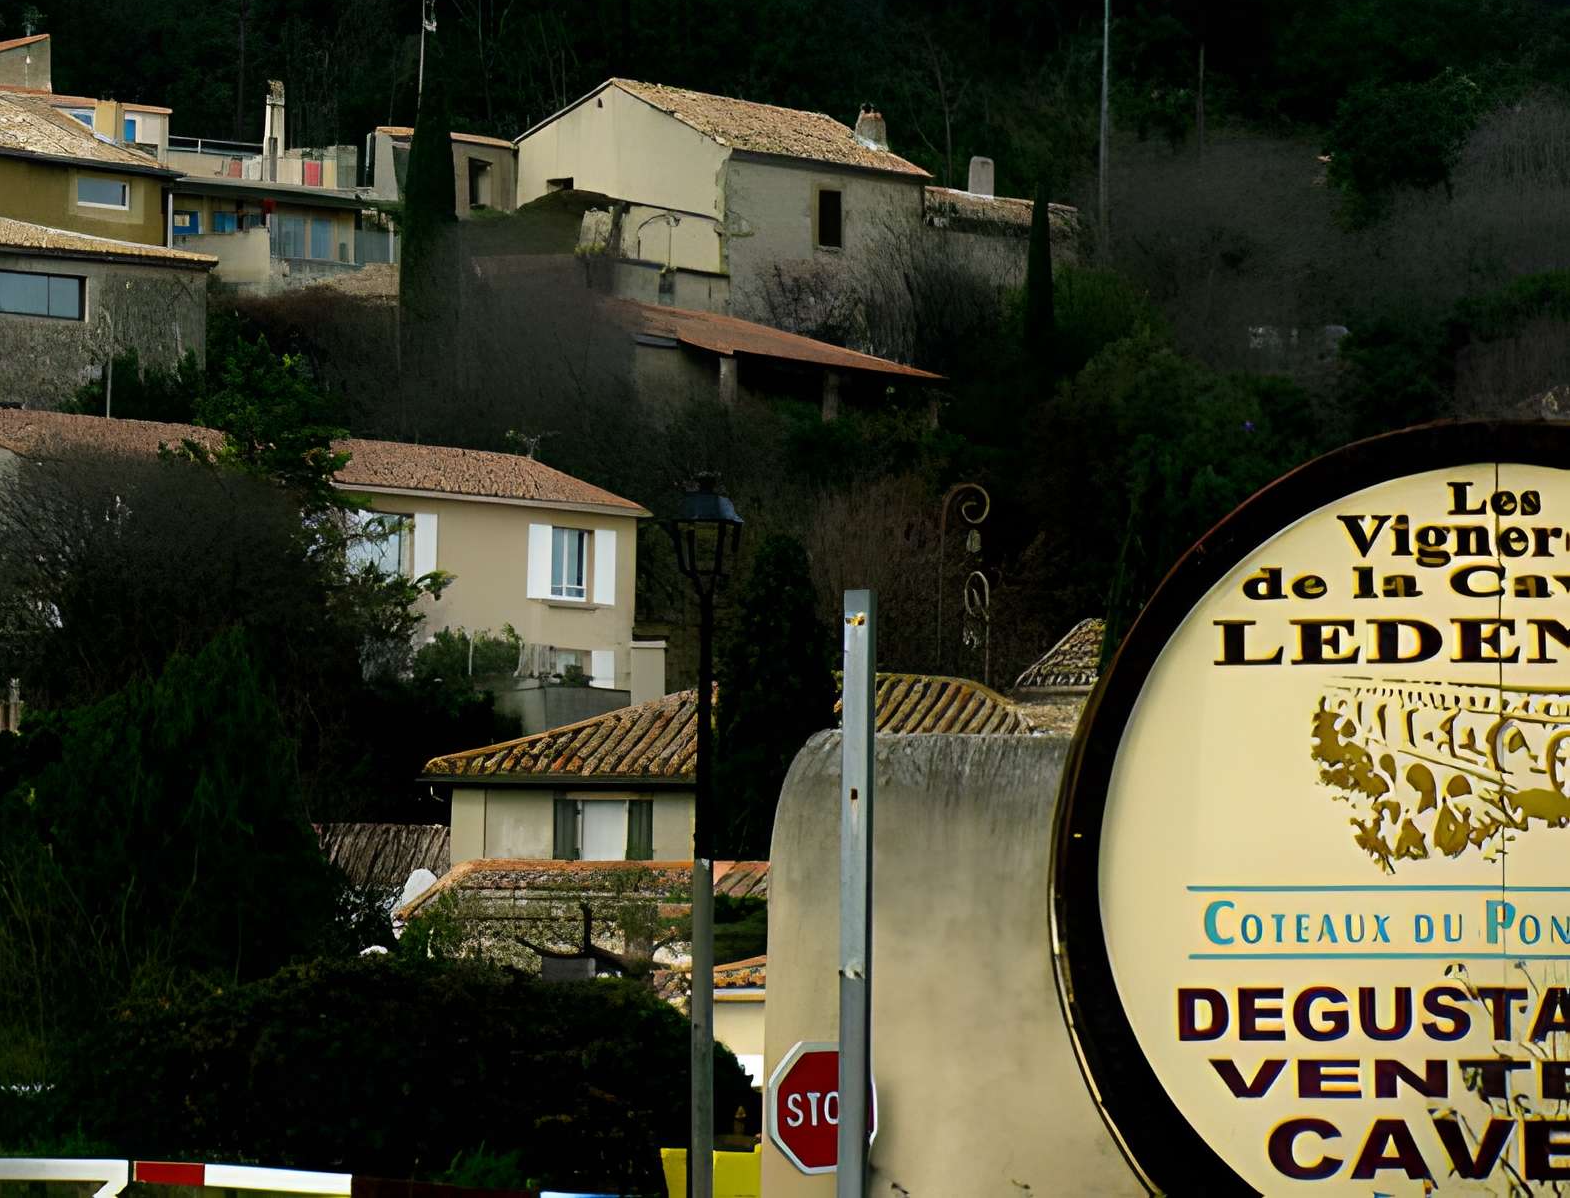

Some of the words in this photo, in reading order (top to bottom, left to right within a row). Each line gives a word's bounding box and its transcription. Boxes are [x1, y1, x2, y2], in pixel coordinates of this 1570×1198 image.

[1446, 481, 1542, 517] Les
[1336, 513, 1570, 568] Vigner
[1242, 567, 1328, 600] de
[1352, 566, 1424, 599] la
[786, 1091, 838, 1127] STO
